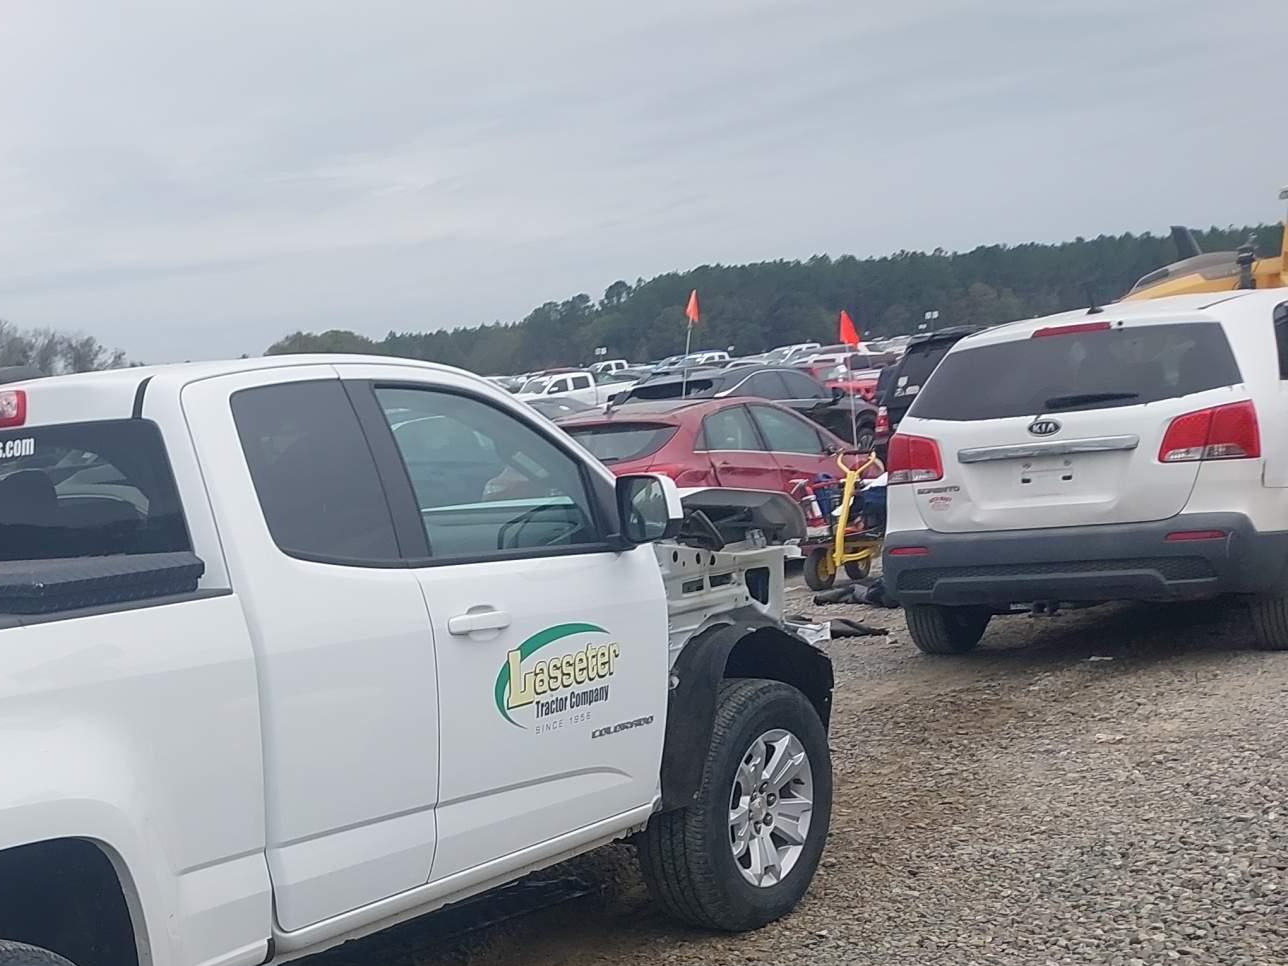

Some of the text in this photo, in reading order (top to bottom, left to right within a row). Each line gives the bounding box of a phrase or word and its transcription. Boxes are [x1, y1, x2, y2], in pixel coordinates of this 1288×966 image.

[1032, 422, 1056, 433] KIA
[507, 642, 620, 711] Lasseter
[535, 684, 610, 719] Tractor Company
[535, 719, 564, 735] SINCE
[591, 715, 654, 739] COLORADO
